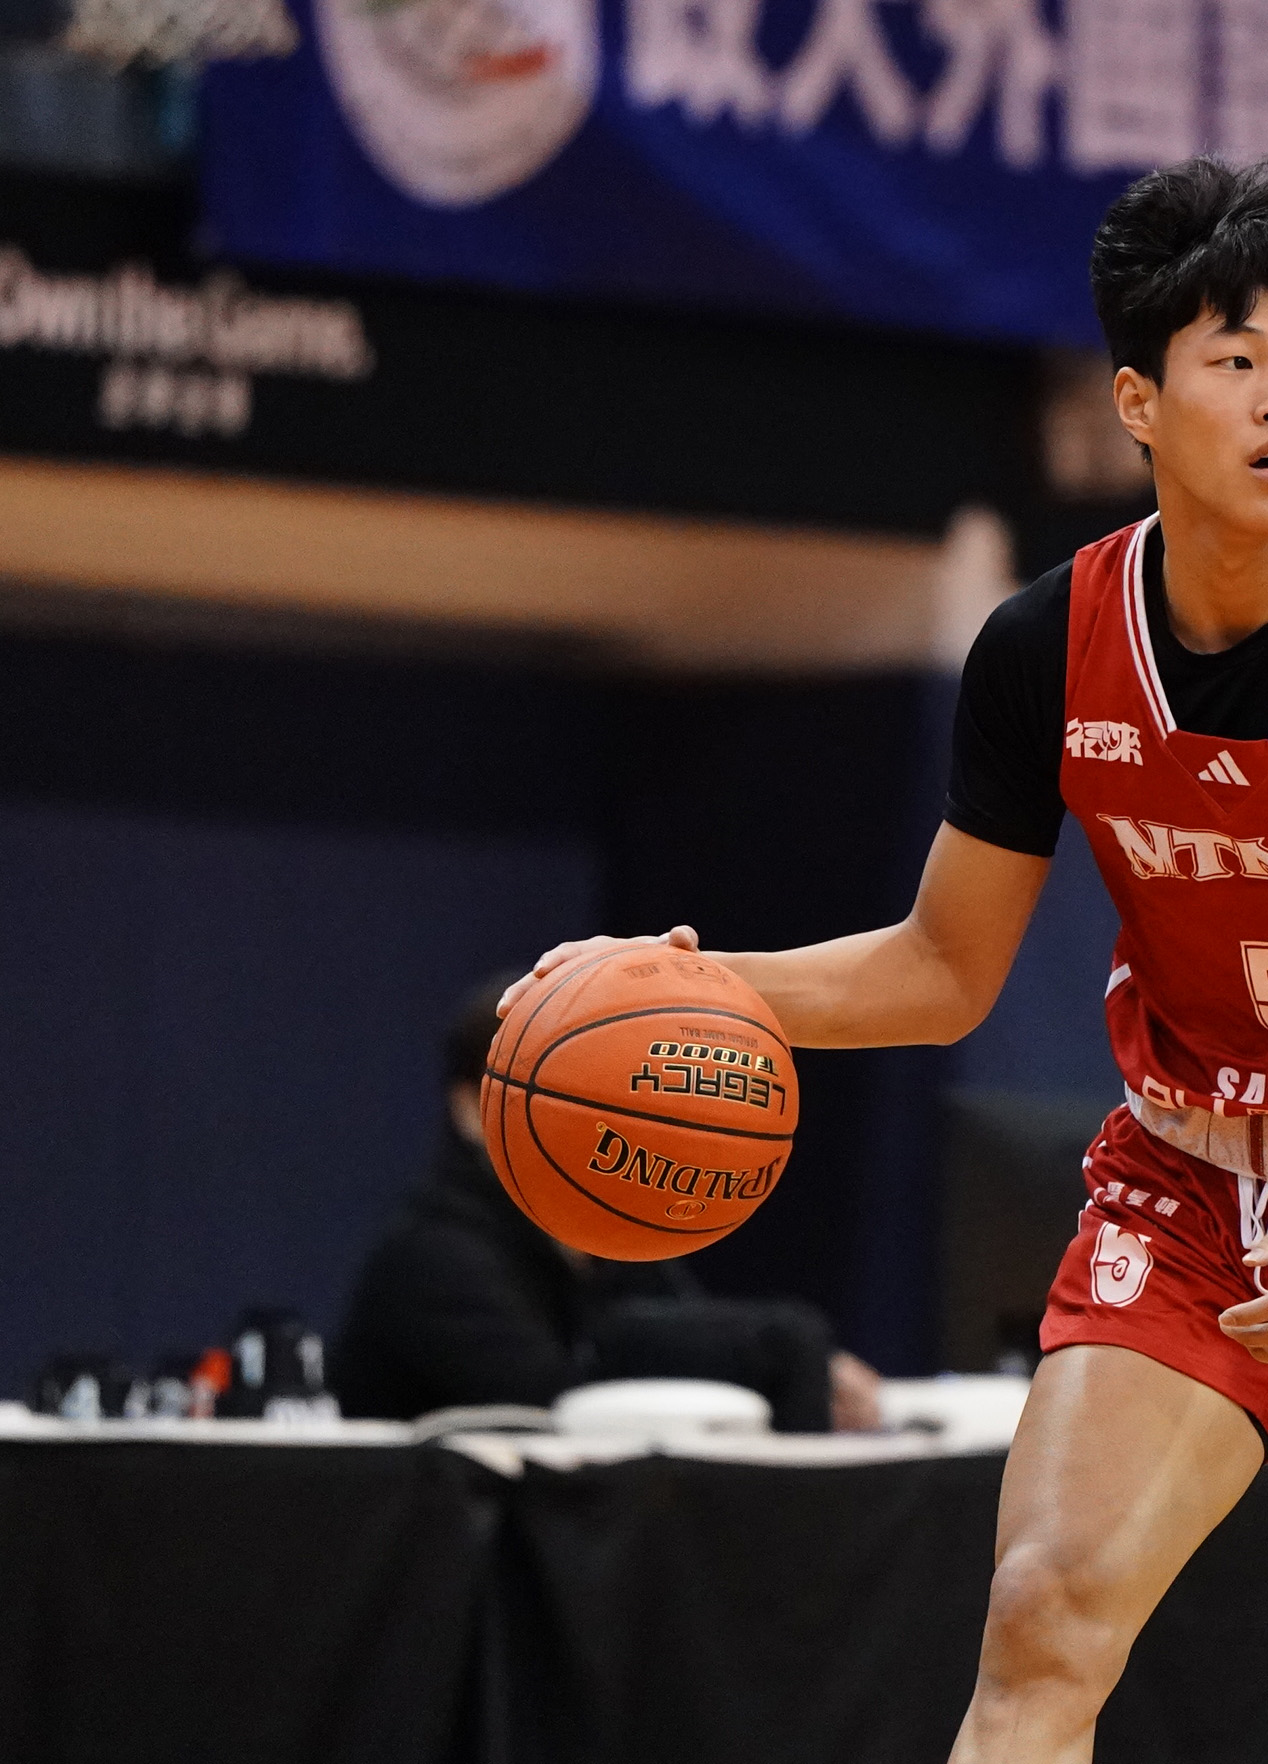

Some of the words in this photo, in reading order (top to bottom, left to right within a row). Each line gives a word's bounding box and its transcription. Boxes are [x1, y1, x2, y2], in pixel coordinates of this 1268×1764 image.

[679, 1026, 701, 1038] BALL
[703, 1029, 726, 1041] GAME
[629, 1061, 786, 1116] LEGACY
[587, 1124, 782, 1201] SPALDING
[1090, 1220, 1154, 1308] 5
